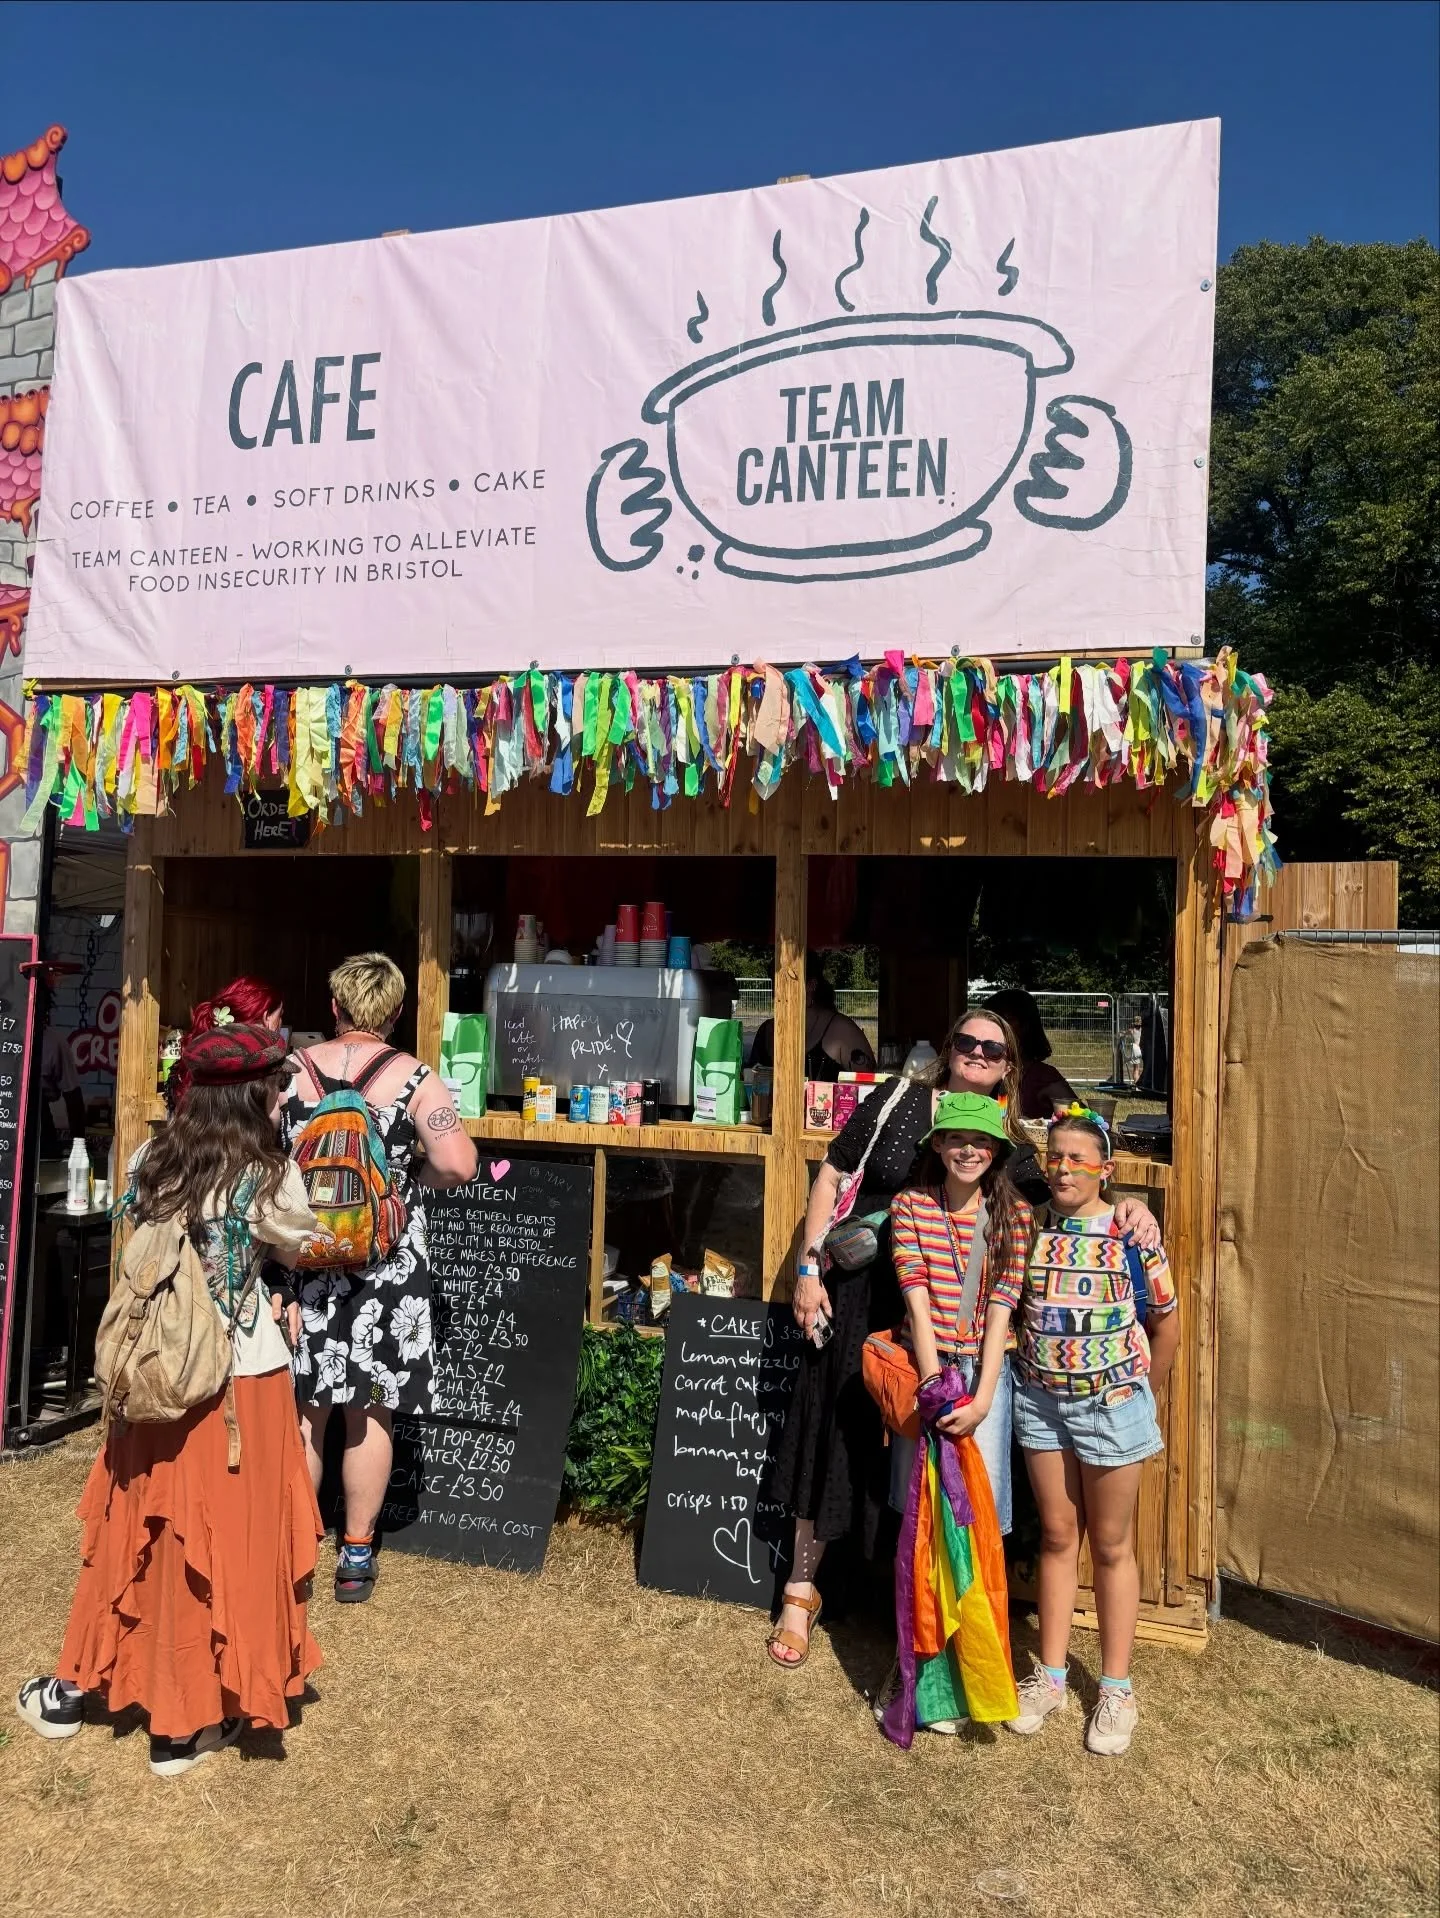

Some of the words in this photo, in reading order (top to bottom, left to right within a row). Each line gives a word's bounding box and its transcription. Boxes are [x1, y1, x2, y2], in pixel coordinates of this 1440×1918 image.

[229, 352, 381, 449] CAFE
[779, 377, 905, 443] TEAM
[736, 437, 948, 505] CANTEEN
[71, 500, 153, 519] COFFEE
[193, 495, 230, 515] TEA
[274, 487, 334, 508] SOFT
[345, 479, 434, 503] DRINKS
[474, 470, 545, 492] CAKE
[72, 550, 120, 568] TEAM
[131, 546, 227, 566] CANTEEN
[253, 537, 363, 559] WORKING
[374, 535, 400, 553] TO
[411, 527, 536, 550] ALLEVIATE
[130, 576, 189, 592] FOOD
[199, 567, 325, 590] INSECURITY
[336, 565, 356, 582] IN
[368, 560, 462, 581] BRISTOL
[247, 798, 288, 818] ORDE
[430, 1207, 461, 1219] LINKS
[429, 1248, 456, 1261] FFEE
[460, 1250, 496, 1262] MAKES
[511, 1252, 577, 1269] DIFFERENCE
[498, 1236, 546, 1251] BRISTOL
